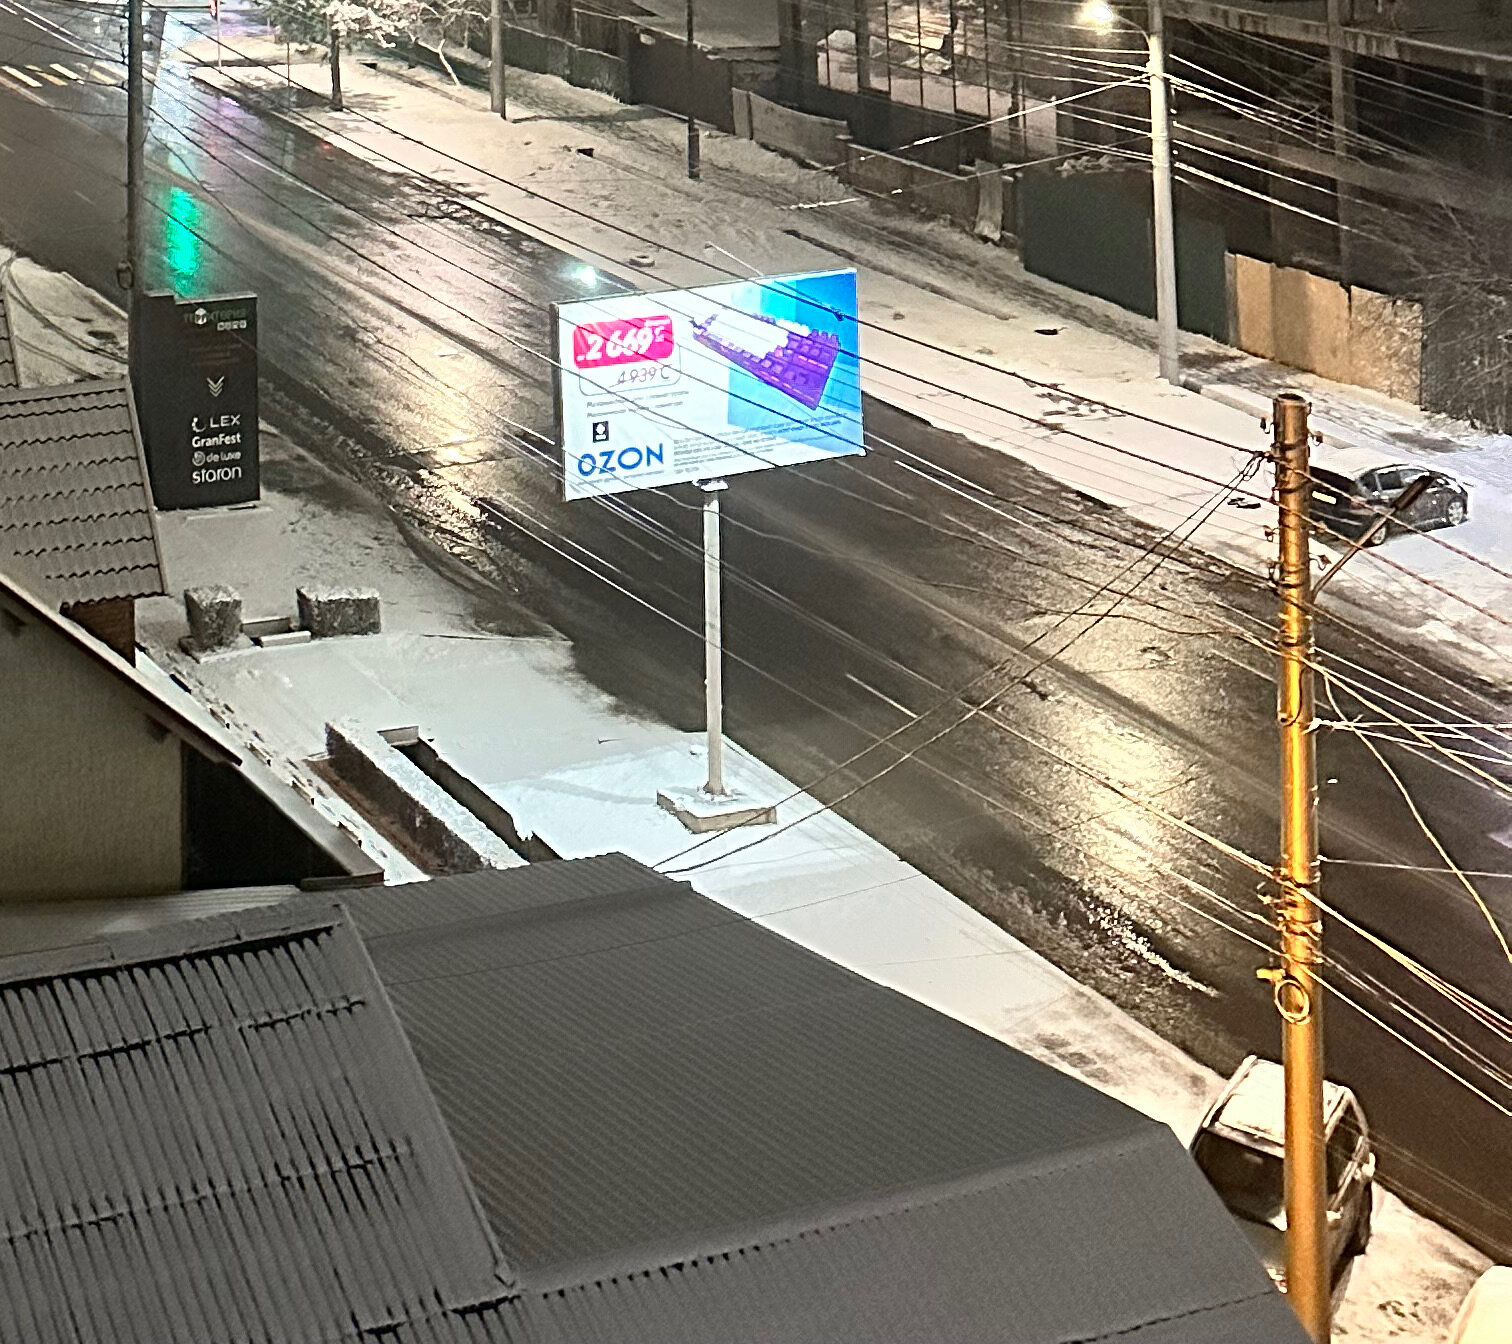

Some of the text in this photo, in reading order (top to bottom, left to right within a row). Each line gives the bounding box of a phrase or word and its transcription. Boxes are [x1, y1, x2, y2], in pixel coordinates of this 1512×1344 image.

[210, 414, 241, 428] LEX
[192, 432, 241, 448] GranFest
[577, 443, 664, 477] OZON
